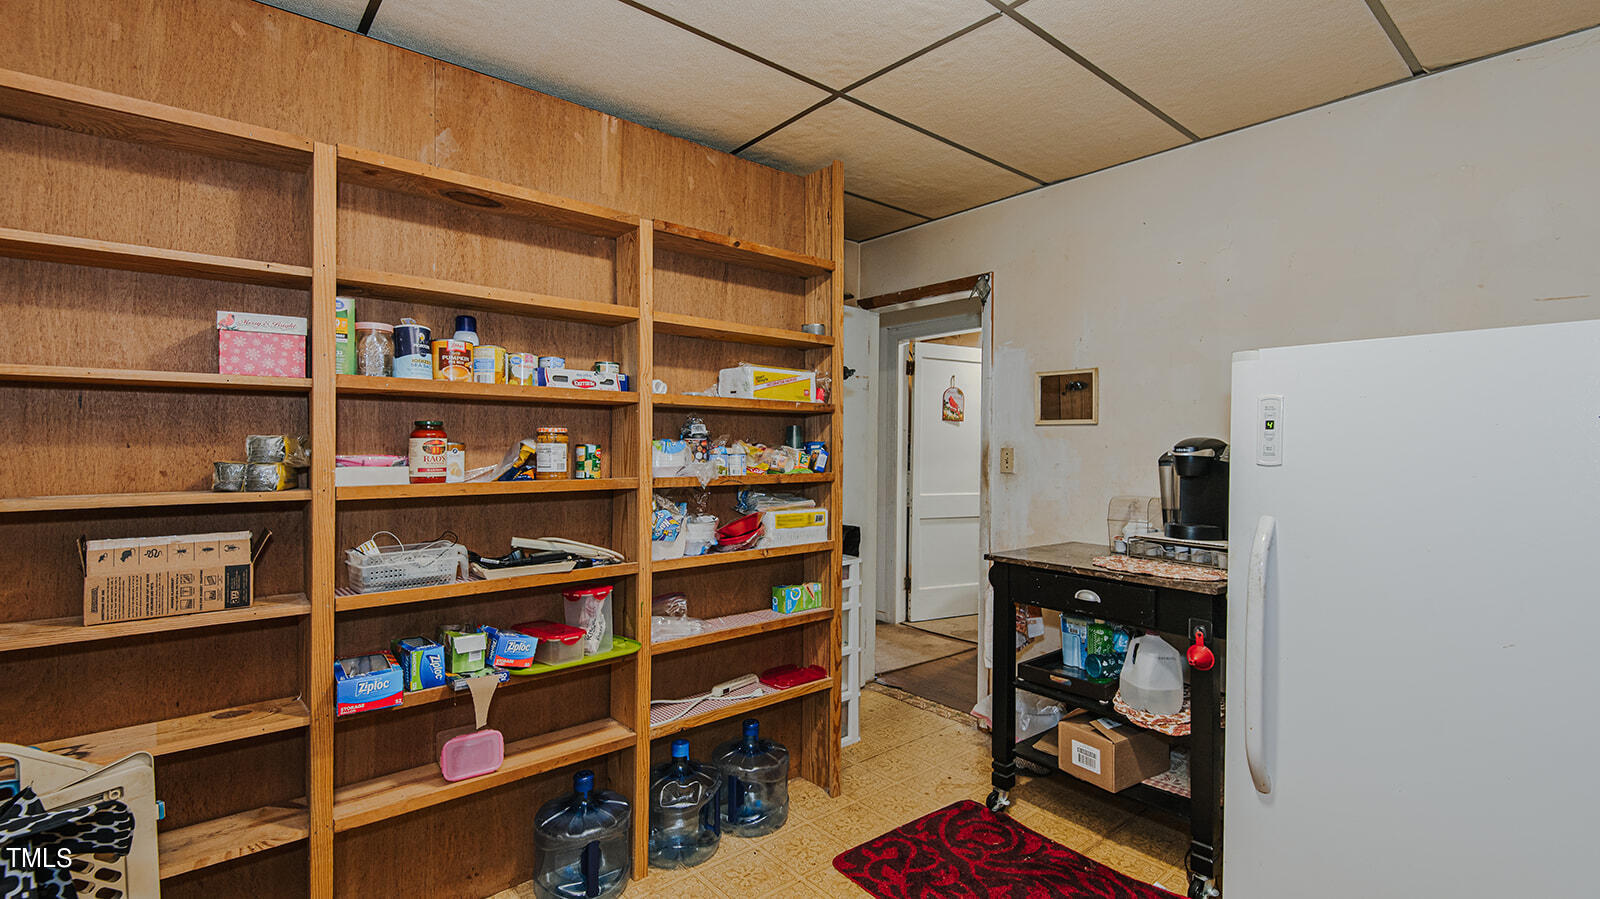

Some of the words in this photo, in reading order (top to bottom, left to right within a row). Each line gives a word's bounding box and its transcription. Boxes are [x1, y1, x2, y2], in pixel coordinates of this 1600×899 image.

[507, 640, 531, 654] Ziploc
[429, 654, 443, 681] Ziploc
[358, 679, 390, 695] Ziploc
